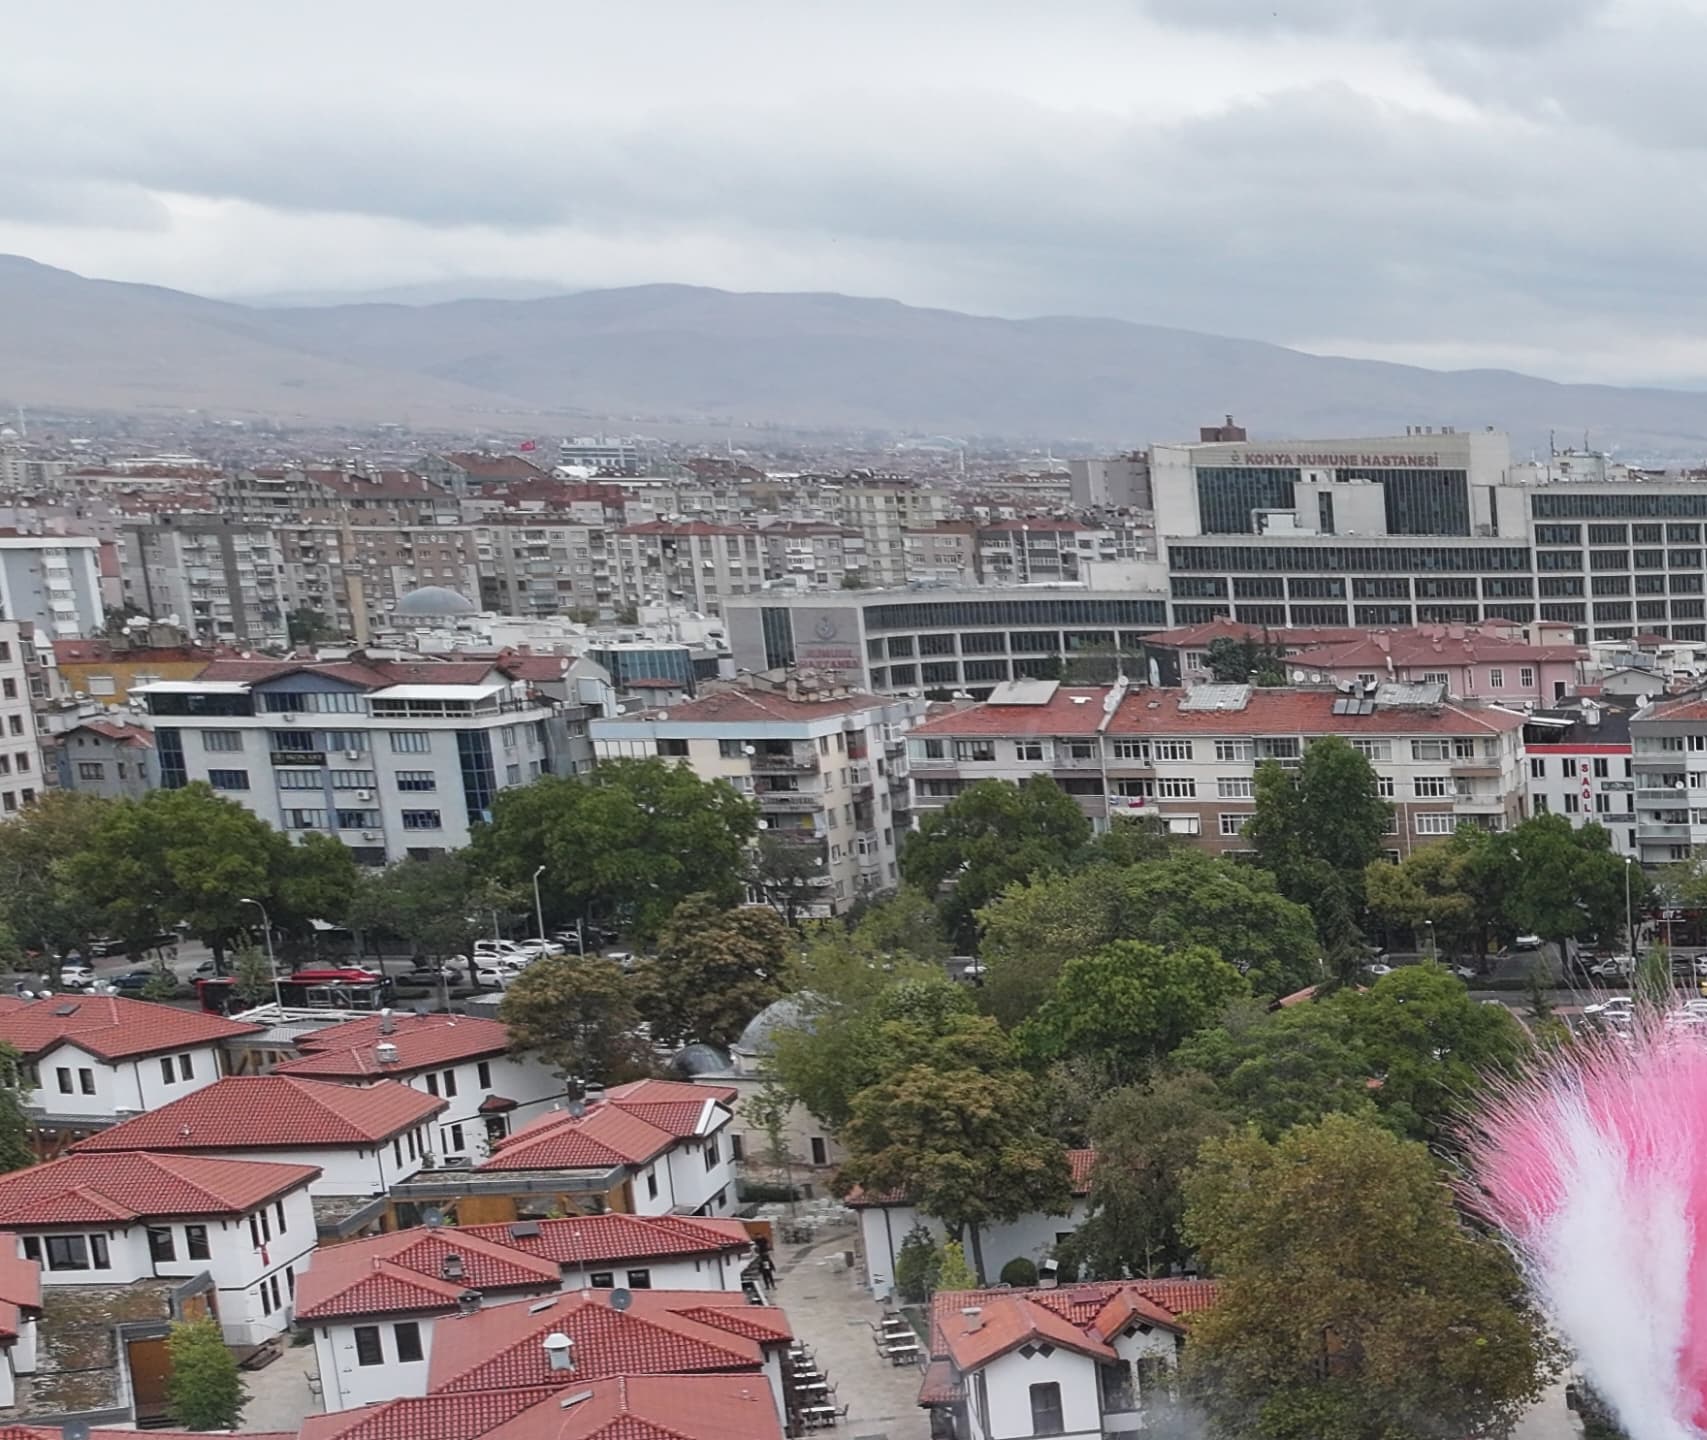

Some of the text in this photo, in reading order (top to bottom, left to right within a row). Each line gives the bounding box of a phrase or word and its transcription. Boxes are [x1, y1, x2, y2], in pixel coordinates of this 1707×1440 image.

[1245, 451, 1440, 467] KONYA NUMUNE HASTANESİ
